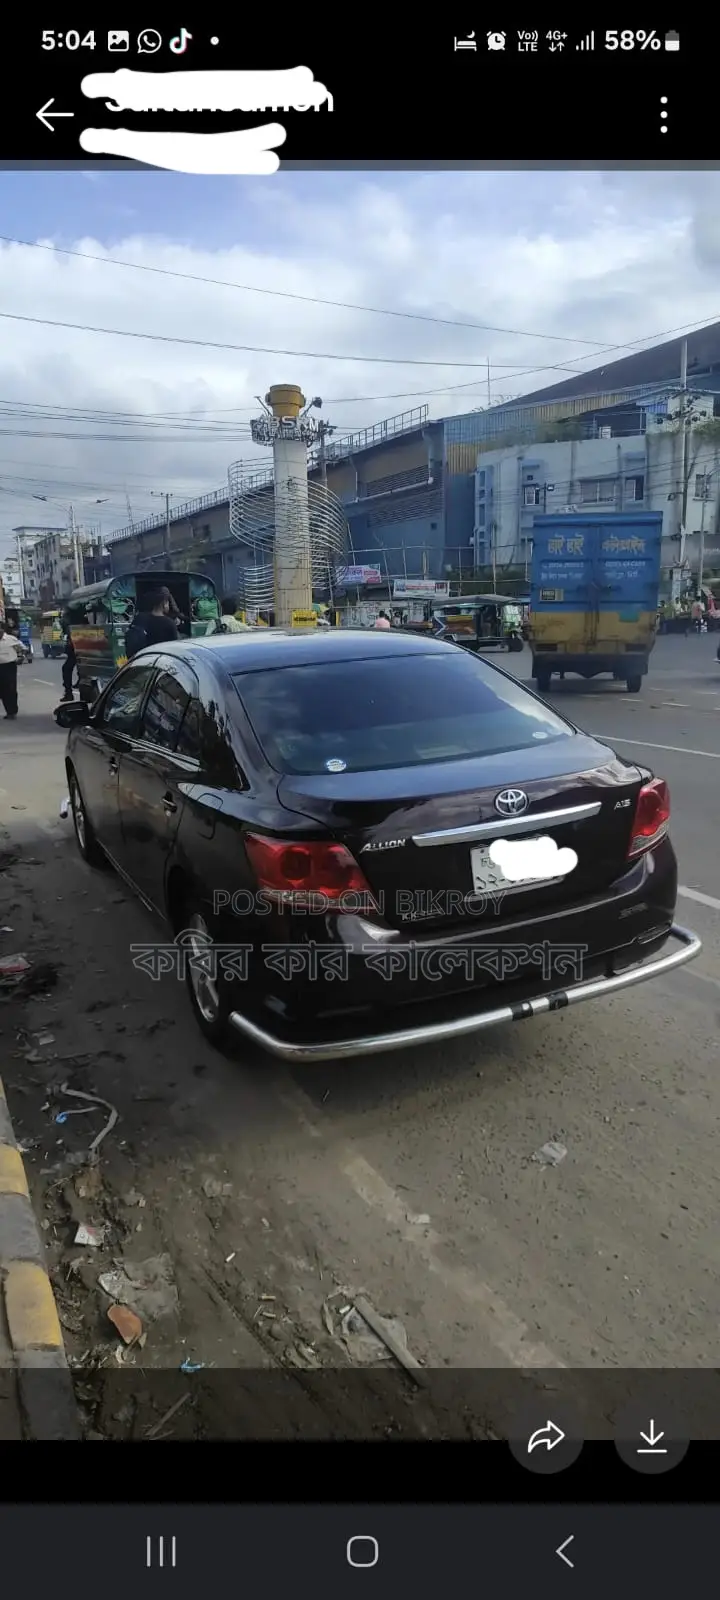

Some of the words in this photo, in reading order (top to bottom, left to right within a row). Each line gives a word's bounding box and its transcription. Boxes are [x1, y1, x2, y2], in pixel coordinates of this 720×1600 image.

[41, 30, 96, 50] 5:04
[546, 30, 568, 41] 4G+
[604, 29, 661, 50] 58%
[517, 41, 538, 52] LTE
[359, 838, 406, 854] ALLION
